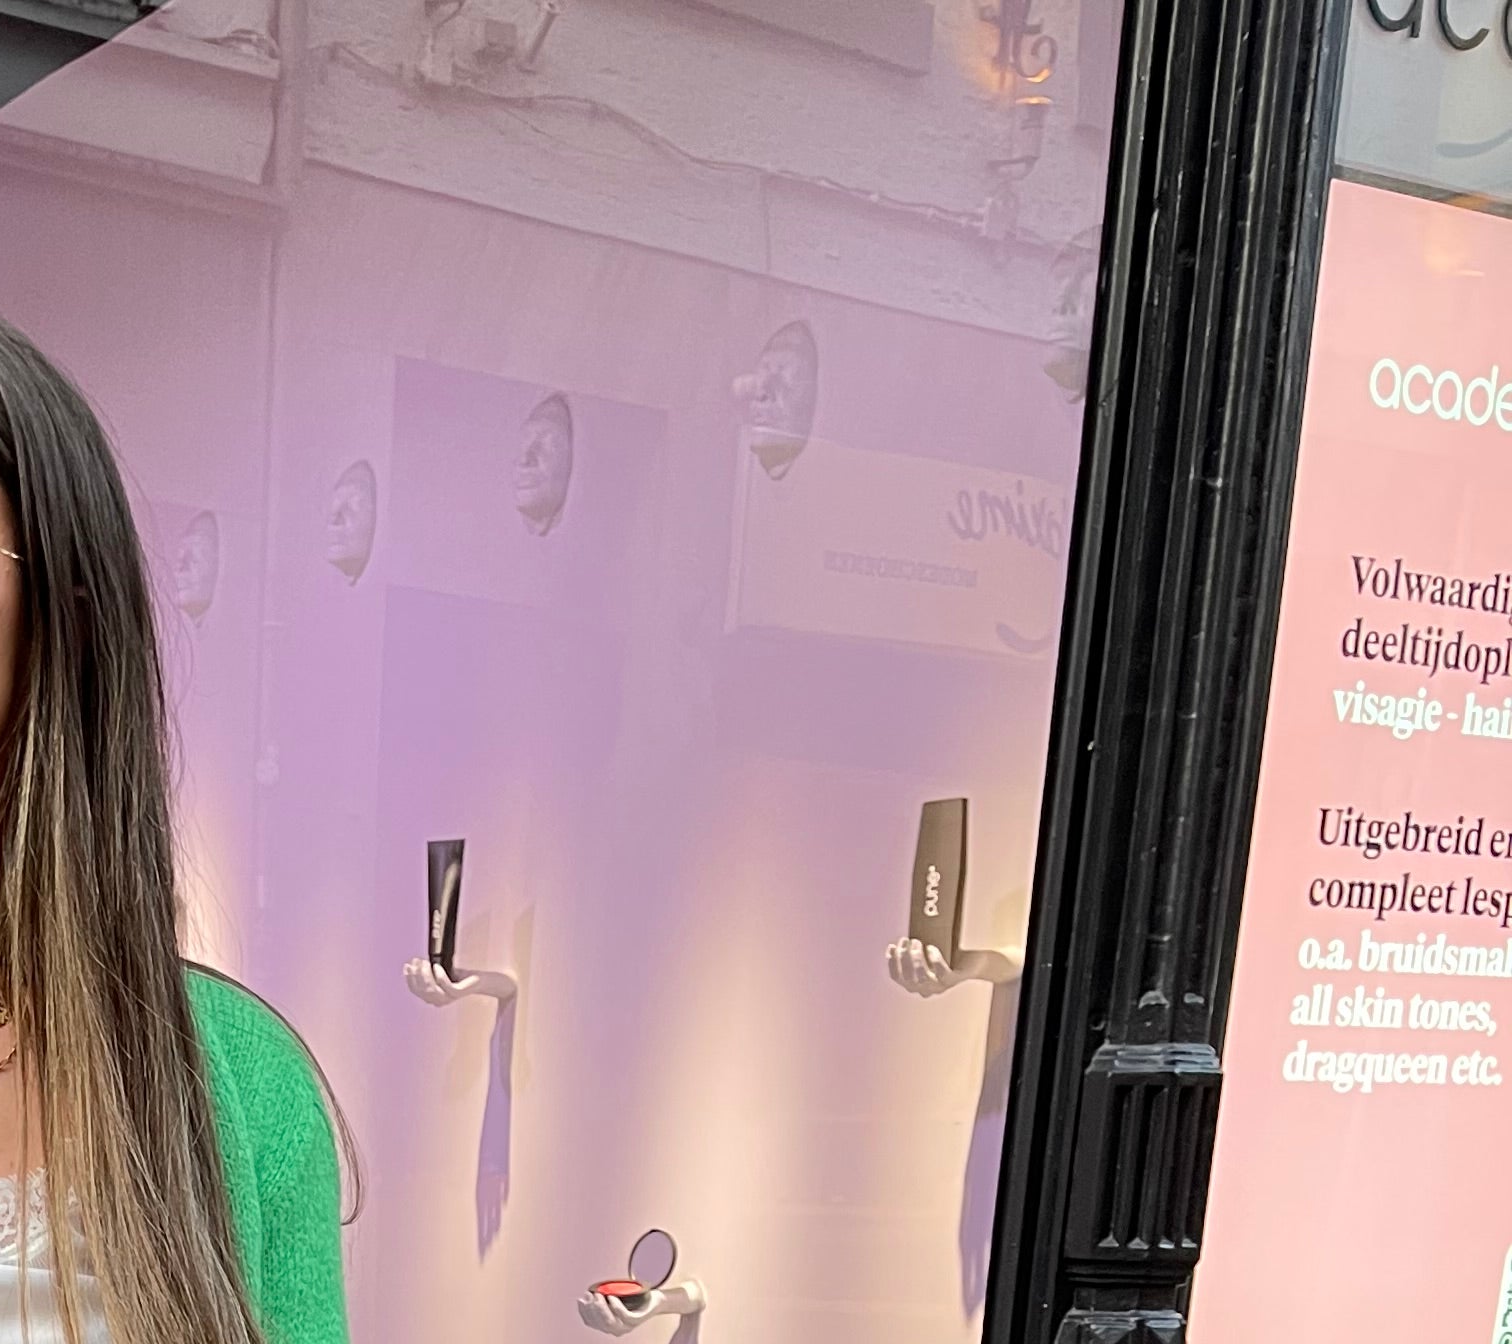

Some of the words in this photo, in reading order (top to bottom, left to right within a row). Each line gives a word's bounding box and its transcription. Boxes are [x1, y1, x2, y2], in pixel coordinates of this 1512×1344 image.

[1352, 555, 1512, 626] Volwaardi
[1333, 680, 1443, 740] visagie
[1319, 807, 1485, 859] Uitgebreid
[1309, 872, 1457, 921] compleet
[1298, 938, 1352, 971] o.a.
[1290, 983, 1333, 1026] all
[1335, 985, 1404, 1029] skin
[1408, 993, 1497, 1037] tones,
[1282, 1040, 1448, 1094] dragqueen
[1451, 1050, 1502, 1086] etc.
